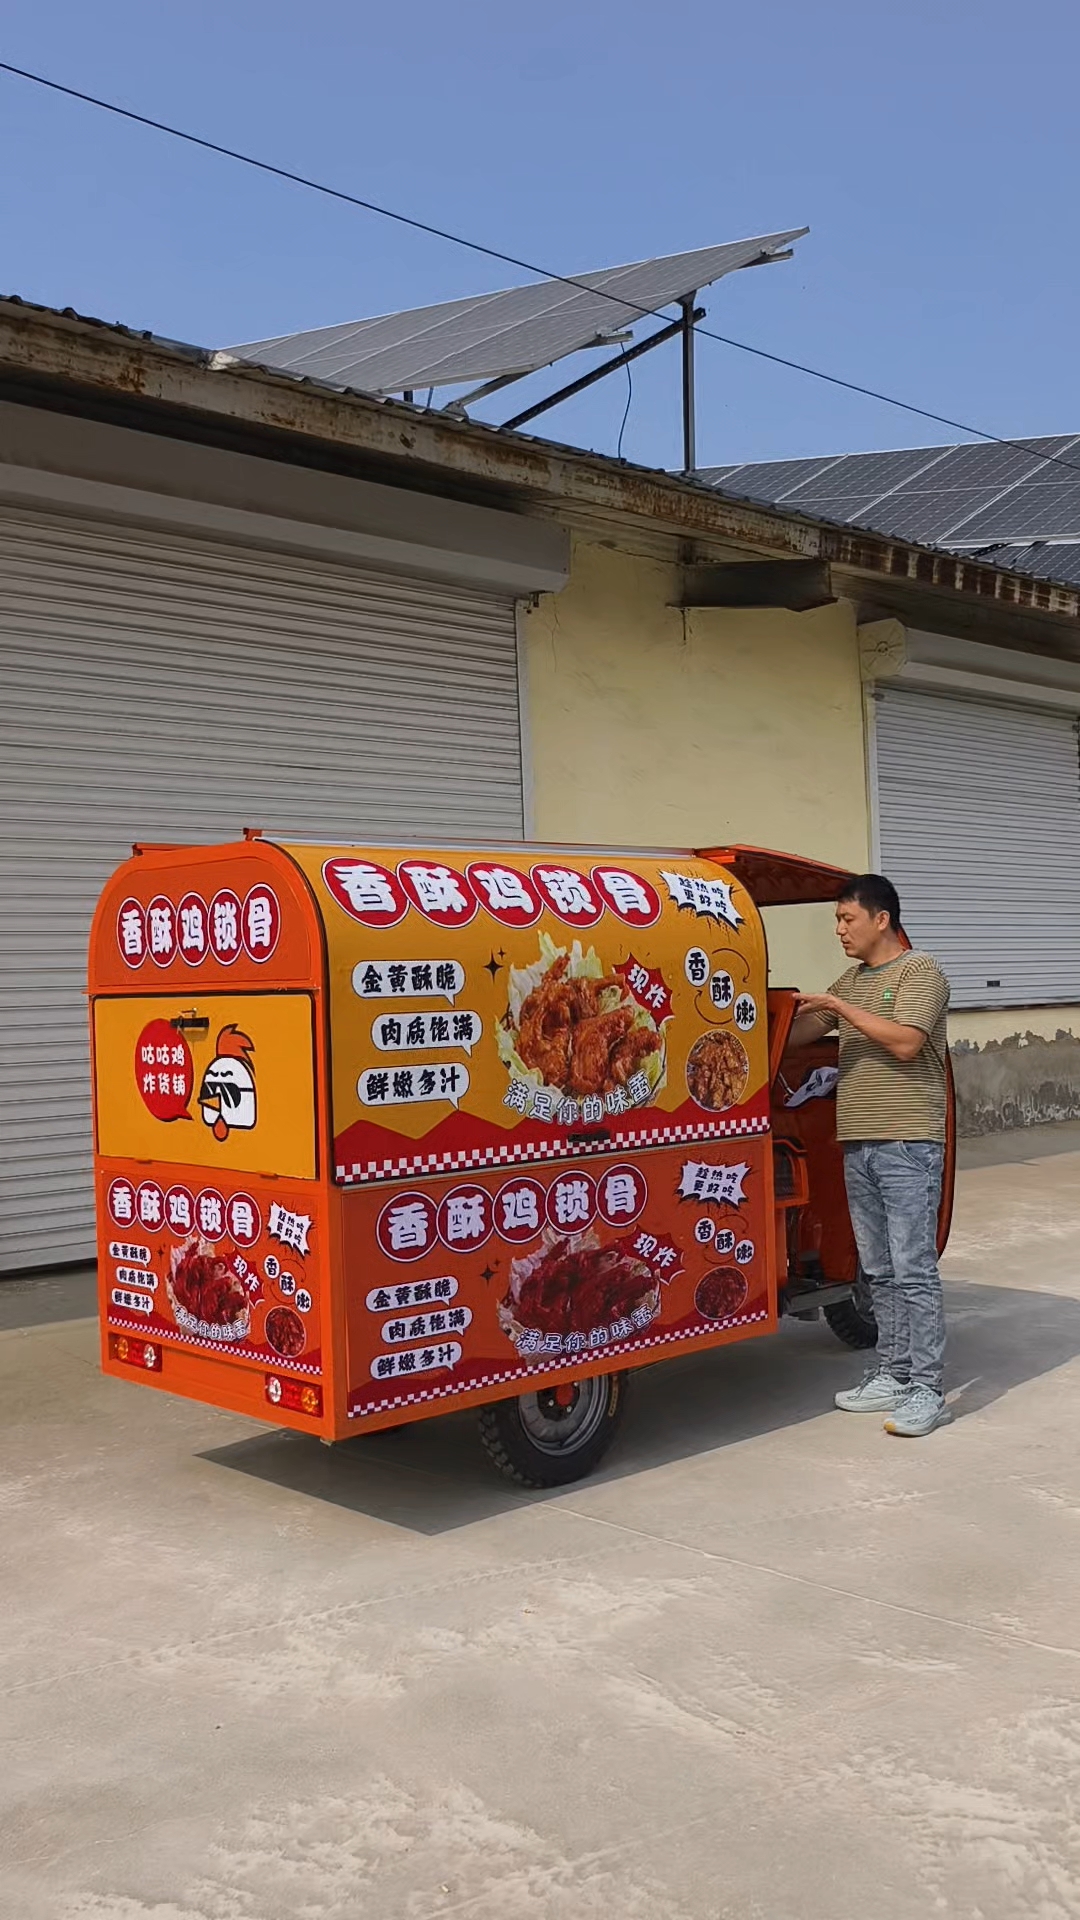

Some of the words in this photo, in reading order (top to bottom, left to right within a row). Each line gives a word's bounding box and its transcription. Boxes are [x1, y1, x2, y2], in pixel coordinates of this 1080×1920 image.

[335, 864, 650, 915] 香酥鸡锁骨
[679, 876, 725, 898] 趁热吃
[682, 889, 728, 913] 更好吃
[121, 897, 272, 955] 香酥鸡锁骨
[361, 963, 456, 993] 金黄酥脆
[627, 964, 666, 1008] 现炸
[380, 1015, 474, 1046] 肉质饱满
[142, 1046, 185, 1066] 咕咕鸡
[143, 1075, 186, 1096] 炸货铺
[366, 1067, 461, 1101] 鲜嫩多汁
[502, 1071, 650, 1125] 满足你的味蕾
[694, 1180, 733, 1197] 更好吃
[696, 1167, 738, 1183] 趁热吃
[113, 1187, 254, 1238] 香酥鸡锁骨
[388, 1175, 636, 1250] 香酥鸡锁骨
[633, 1234, 677, 1268] 现炸
[233, 1256, 260, 1293] 现炸
[373, 1280, 451, 1310] 金黄酥脆
[388, 1310, 465, 1340] 肉质饱满
[515, 1305, 653, 1354] 满足你的味蕾
[377, 1346, 455, 1376] 鲜嫩多汁
